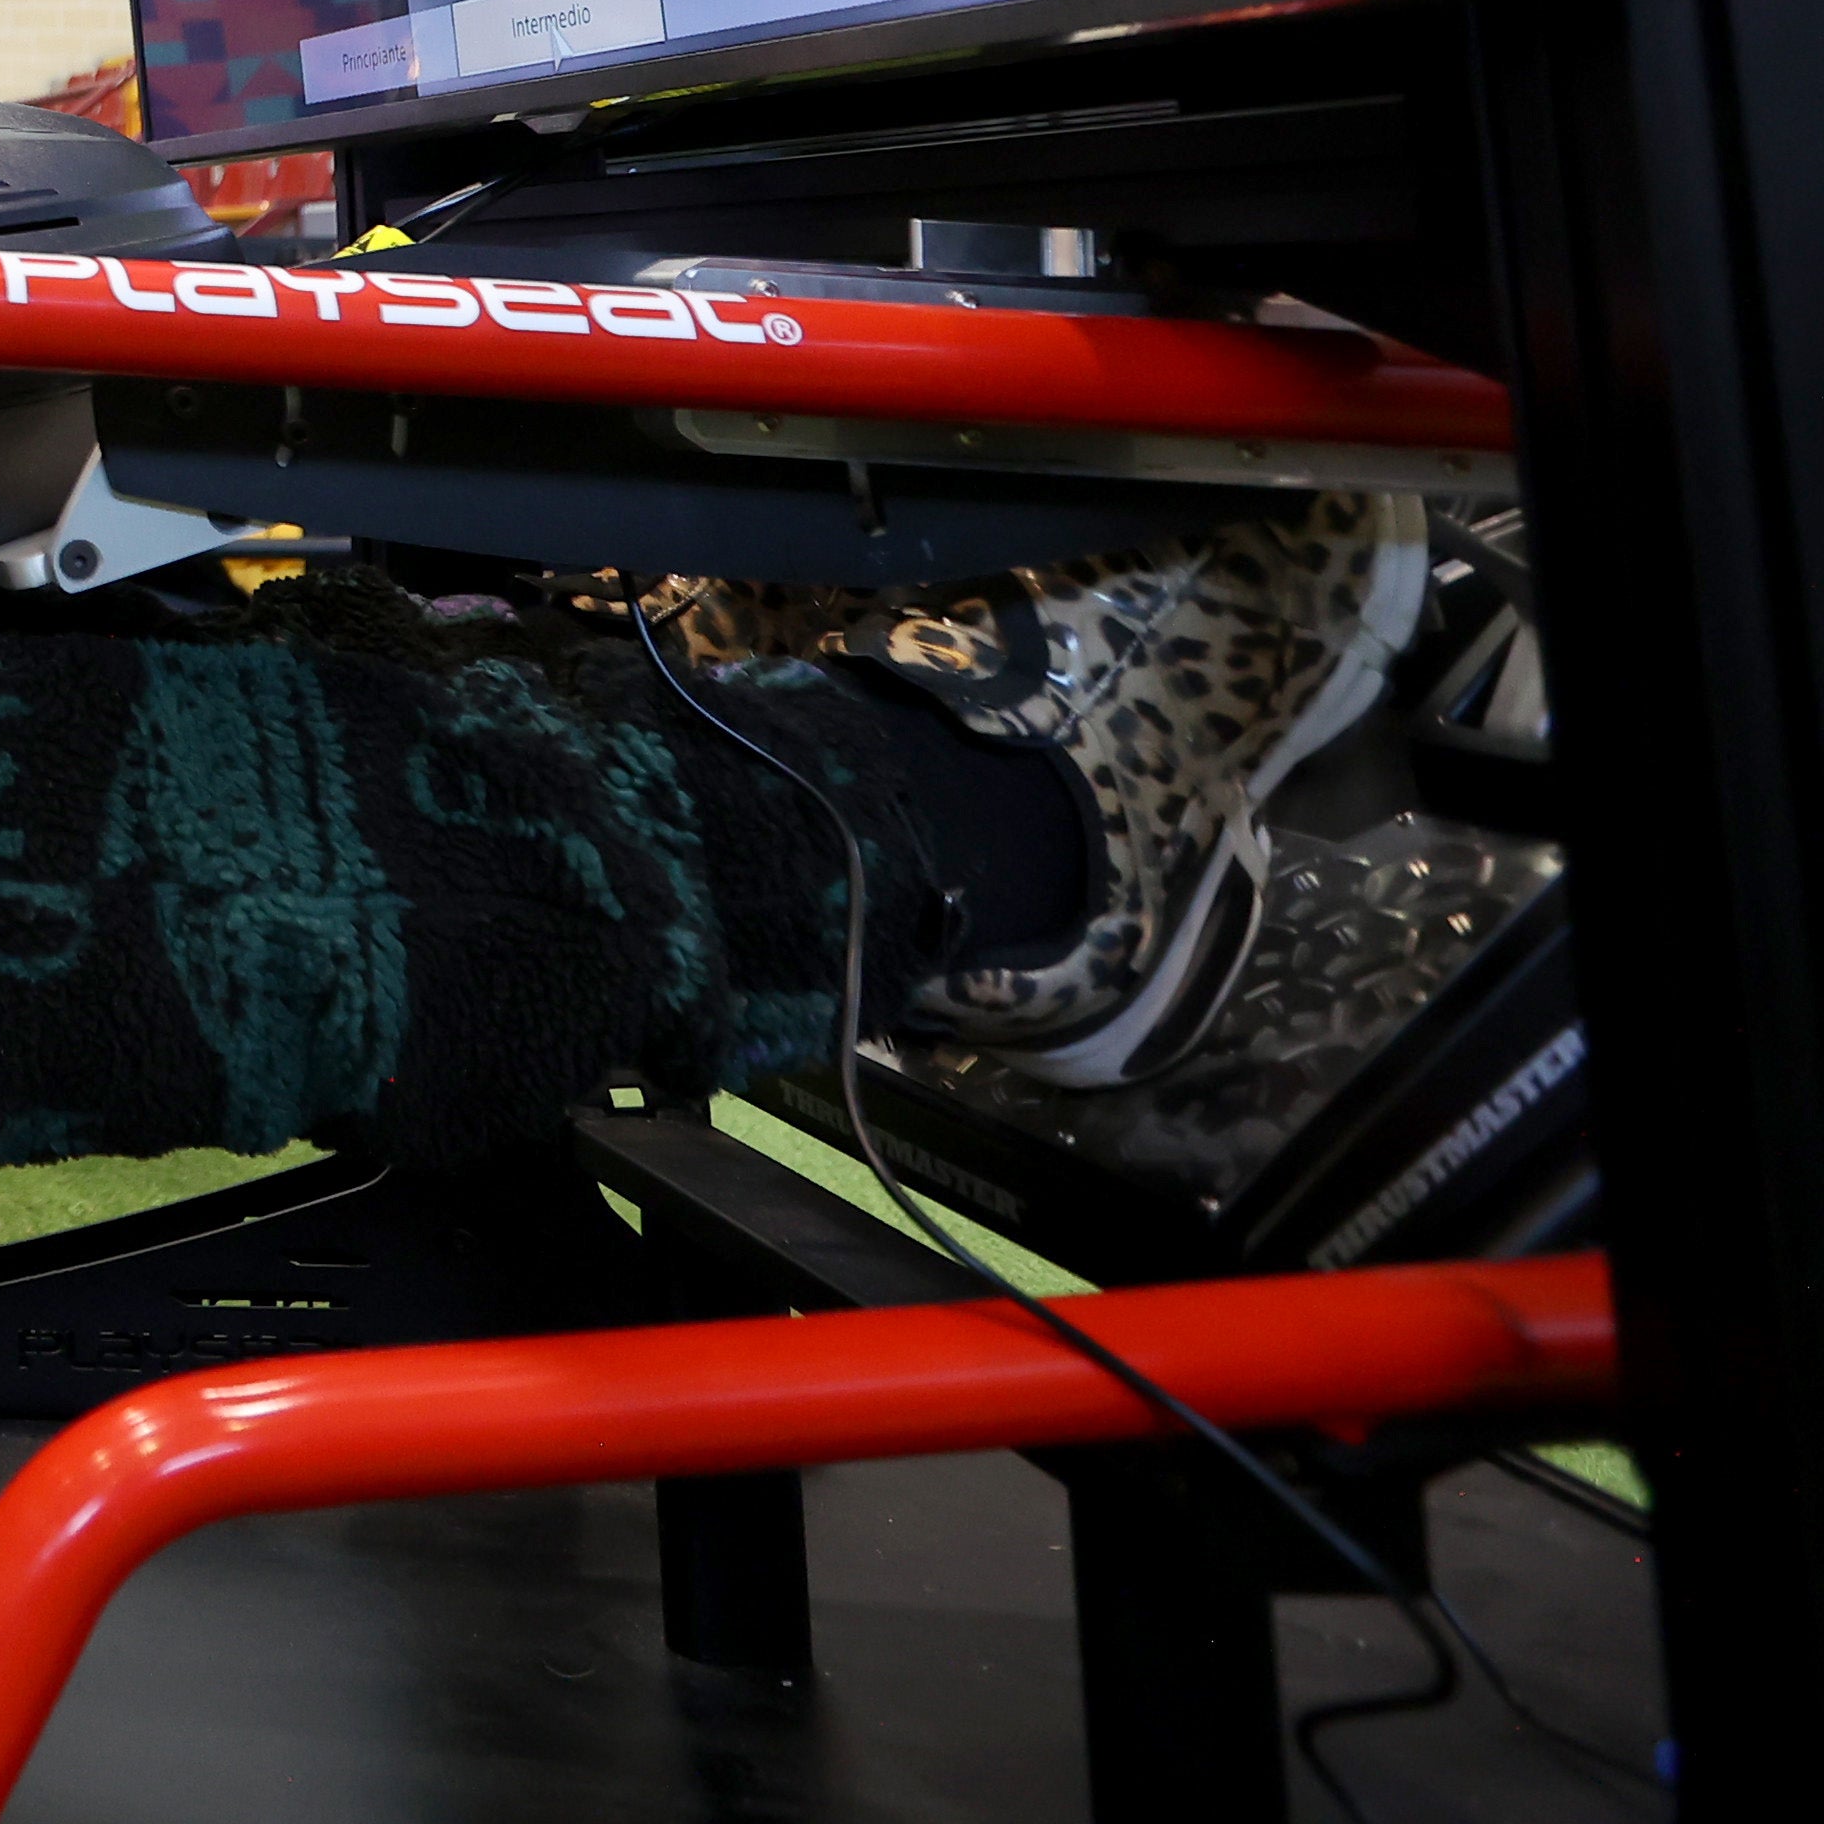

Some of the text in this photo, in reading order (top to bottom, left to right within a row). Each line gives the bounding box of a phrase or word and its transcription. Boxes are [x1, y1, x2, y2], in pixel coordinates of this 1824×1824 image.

[341, 41, 407, 74] Principiante
[510, 3, 592, 39] Intermedio
[778, 1077, 1026, 1226] THRUTMASTER
[1307, 1019, 1587, 1271] THRUSTMASTER
